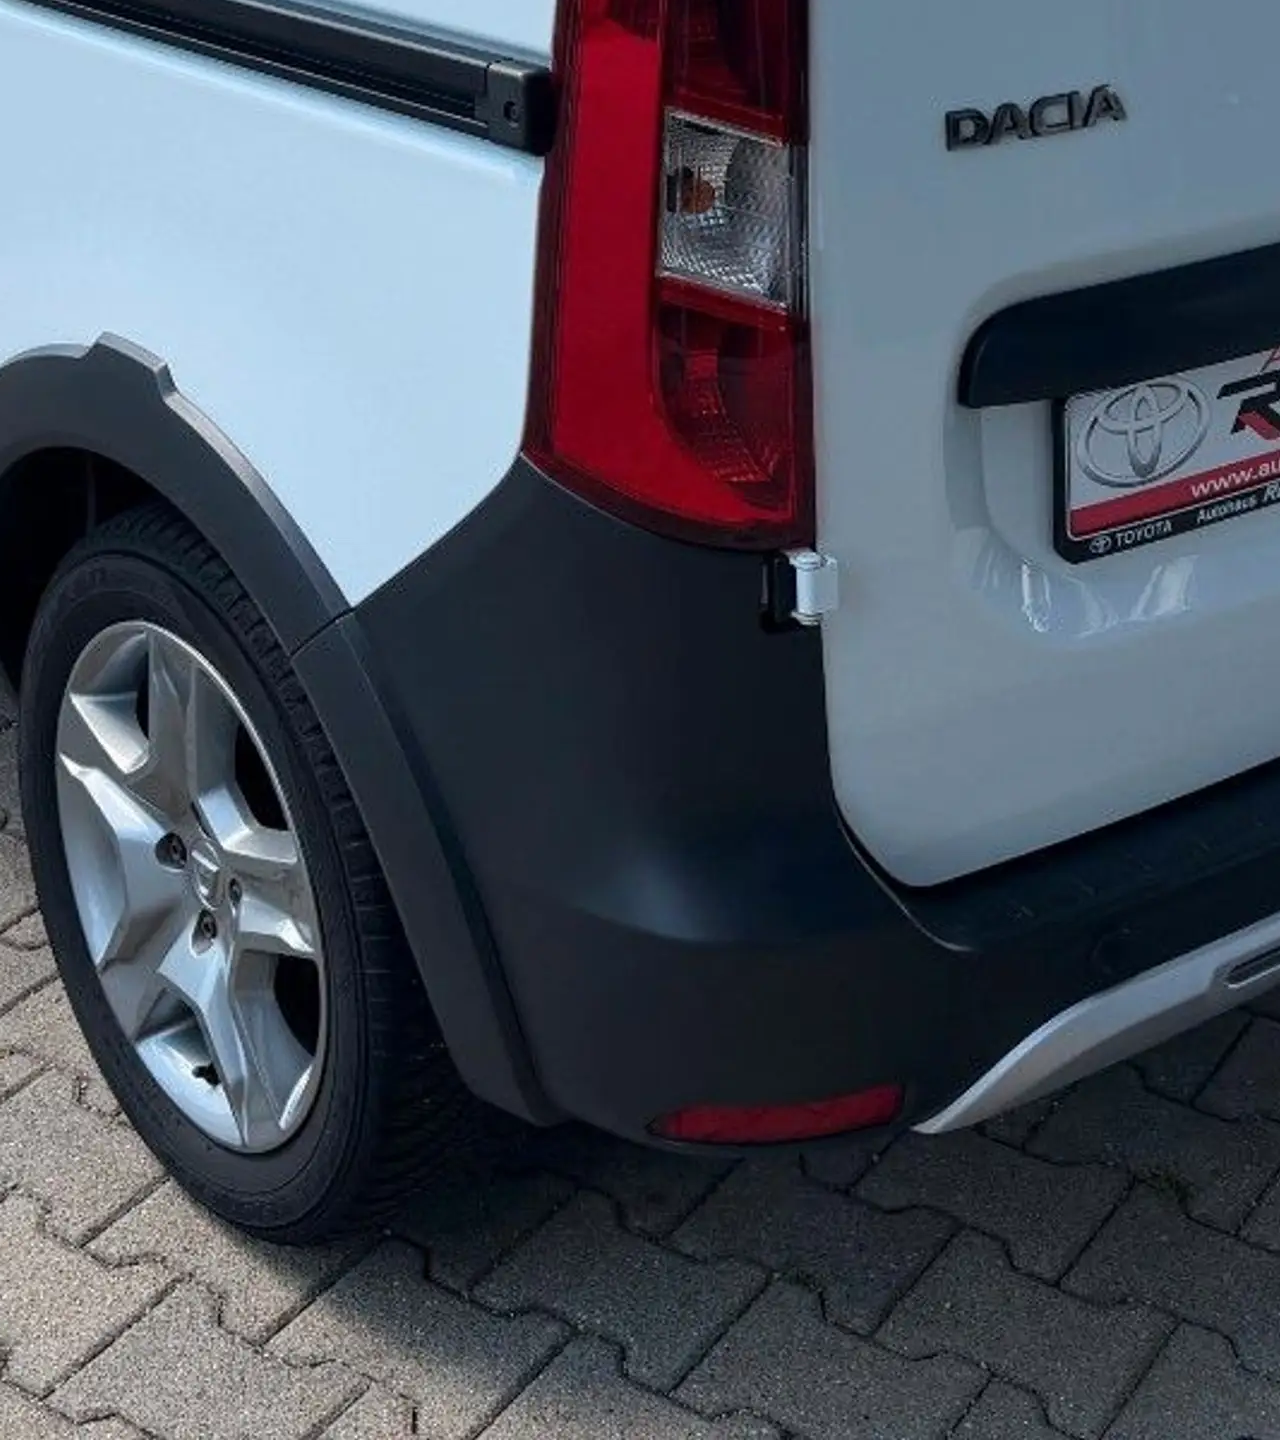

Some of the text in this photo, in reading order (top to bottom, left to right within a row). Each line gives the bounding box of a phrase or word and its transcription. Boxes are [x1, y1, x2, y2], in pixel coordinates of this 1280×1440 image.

[945, 82, 1129, 152] DACIA
[1116, 519, 1173, 547] TOYOTA
[1196, 494, 1258, 524] Autohaus
